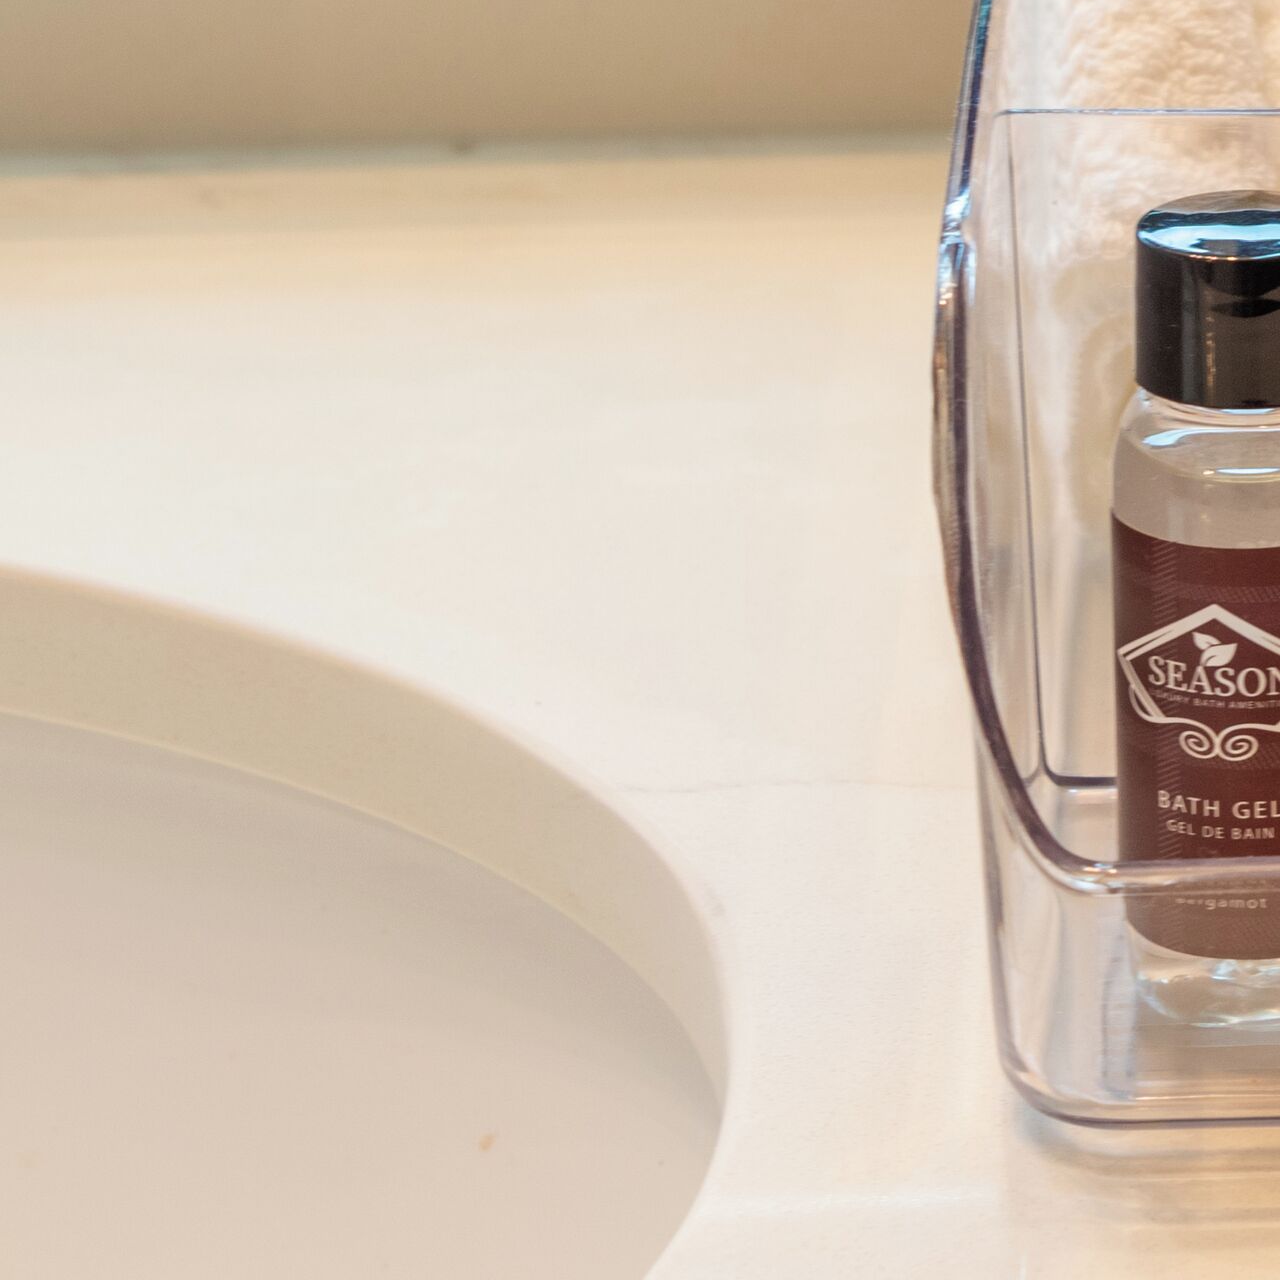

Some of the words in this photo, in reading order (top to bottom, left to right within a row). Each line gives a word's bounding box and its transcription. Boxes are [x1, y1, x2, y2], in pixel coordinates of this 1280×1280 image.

[1193, 698, 1226, 708] BATH
[1157, 789, 1221, 818] BATH
[1166, 819, 1197, 836] GEL
[1201, 825, 1226, 839] DE
[1230, 826, 1276, 840] BAIN
